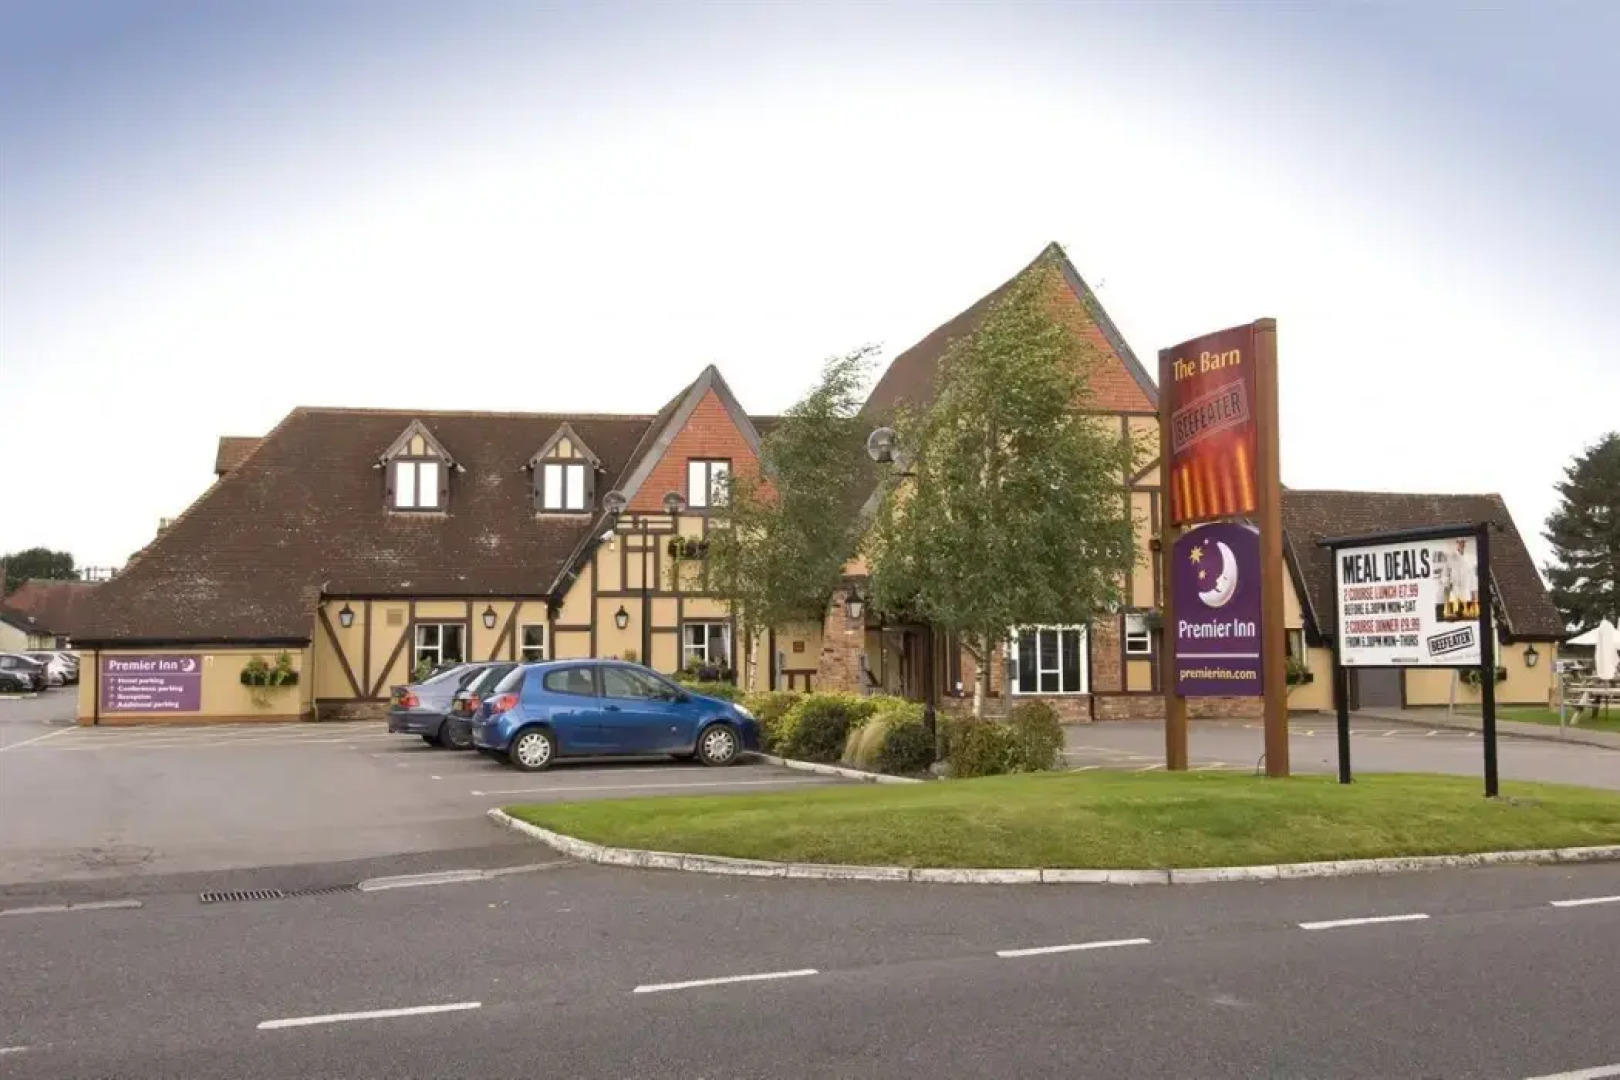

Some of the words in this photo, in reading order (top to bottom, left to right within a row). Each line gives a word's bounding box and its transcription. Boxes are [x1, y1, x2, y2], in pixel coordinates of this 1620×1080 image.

[1173, 357, 1195, 381] The
[1201, 349, 1241, 373] Barn
[1176, 392, 1241, 441] BEEFEATER
[1342, 553, 1381, 584] MEAL
[1384, 548, 1431, 581] DEALS
[1349, 586, 1373, 601] COURSE
[1375, 585, 1397, 600] LUNCH
[1344, 603, 1364, 616] BEFORE
[1179, 618, 1232, 639] Premier
[1233, 618, 1255, 637] Inn
[1350, 619, 1374, 634] COURSE
[1375, 618, 1399, 633] DINNER
[1345, 636, 1360, 648] FROM
[1431, 632, 1470, 652] BEEFEATER
[109, 660, 156, 671] Premier
[159, 660, 178, 671] Inn
[1180, 666, 1257, 682] premierinn.com
